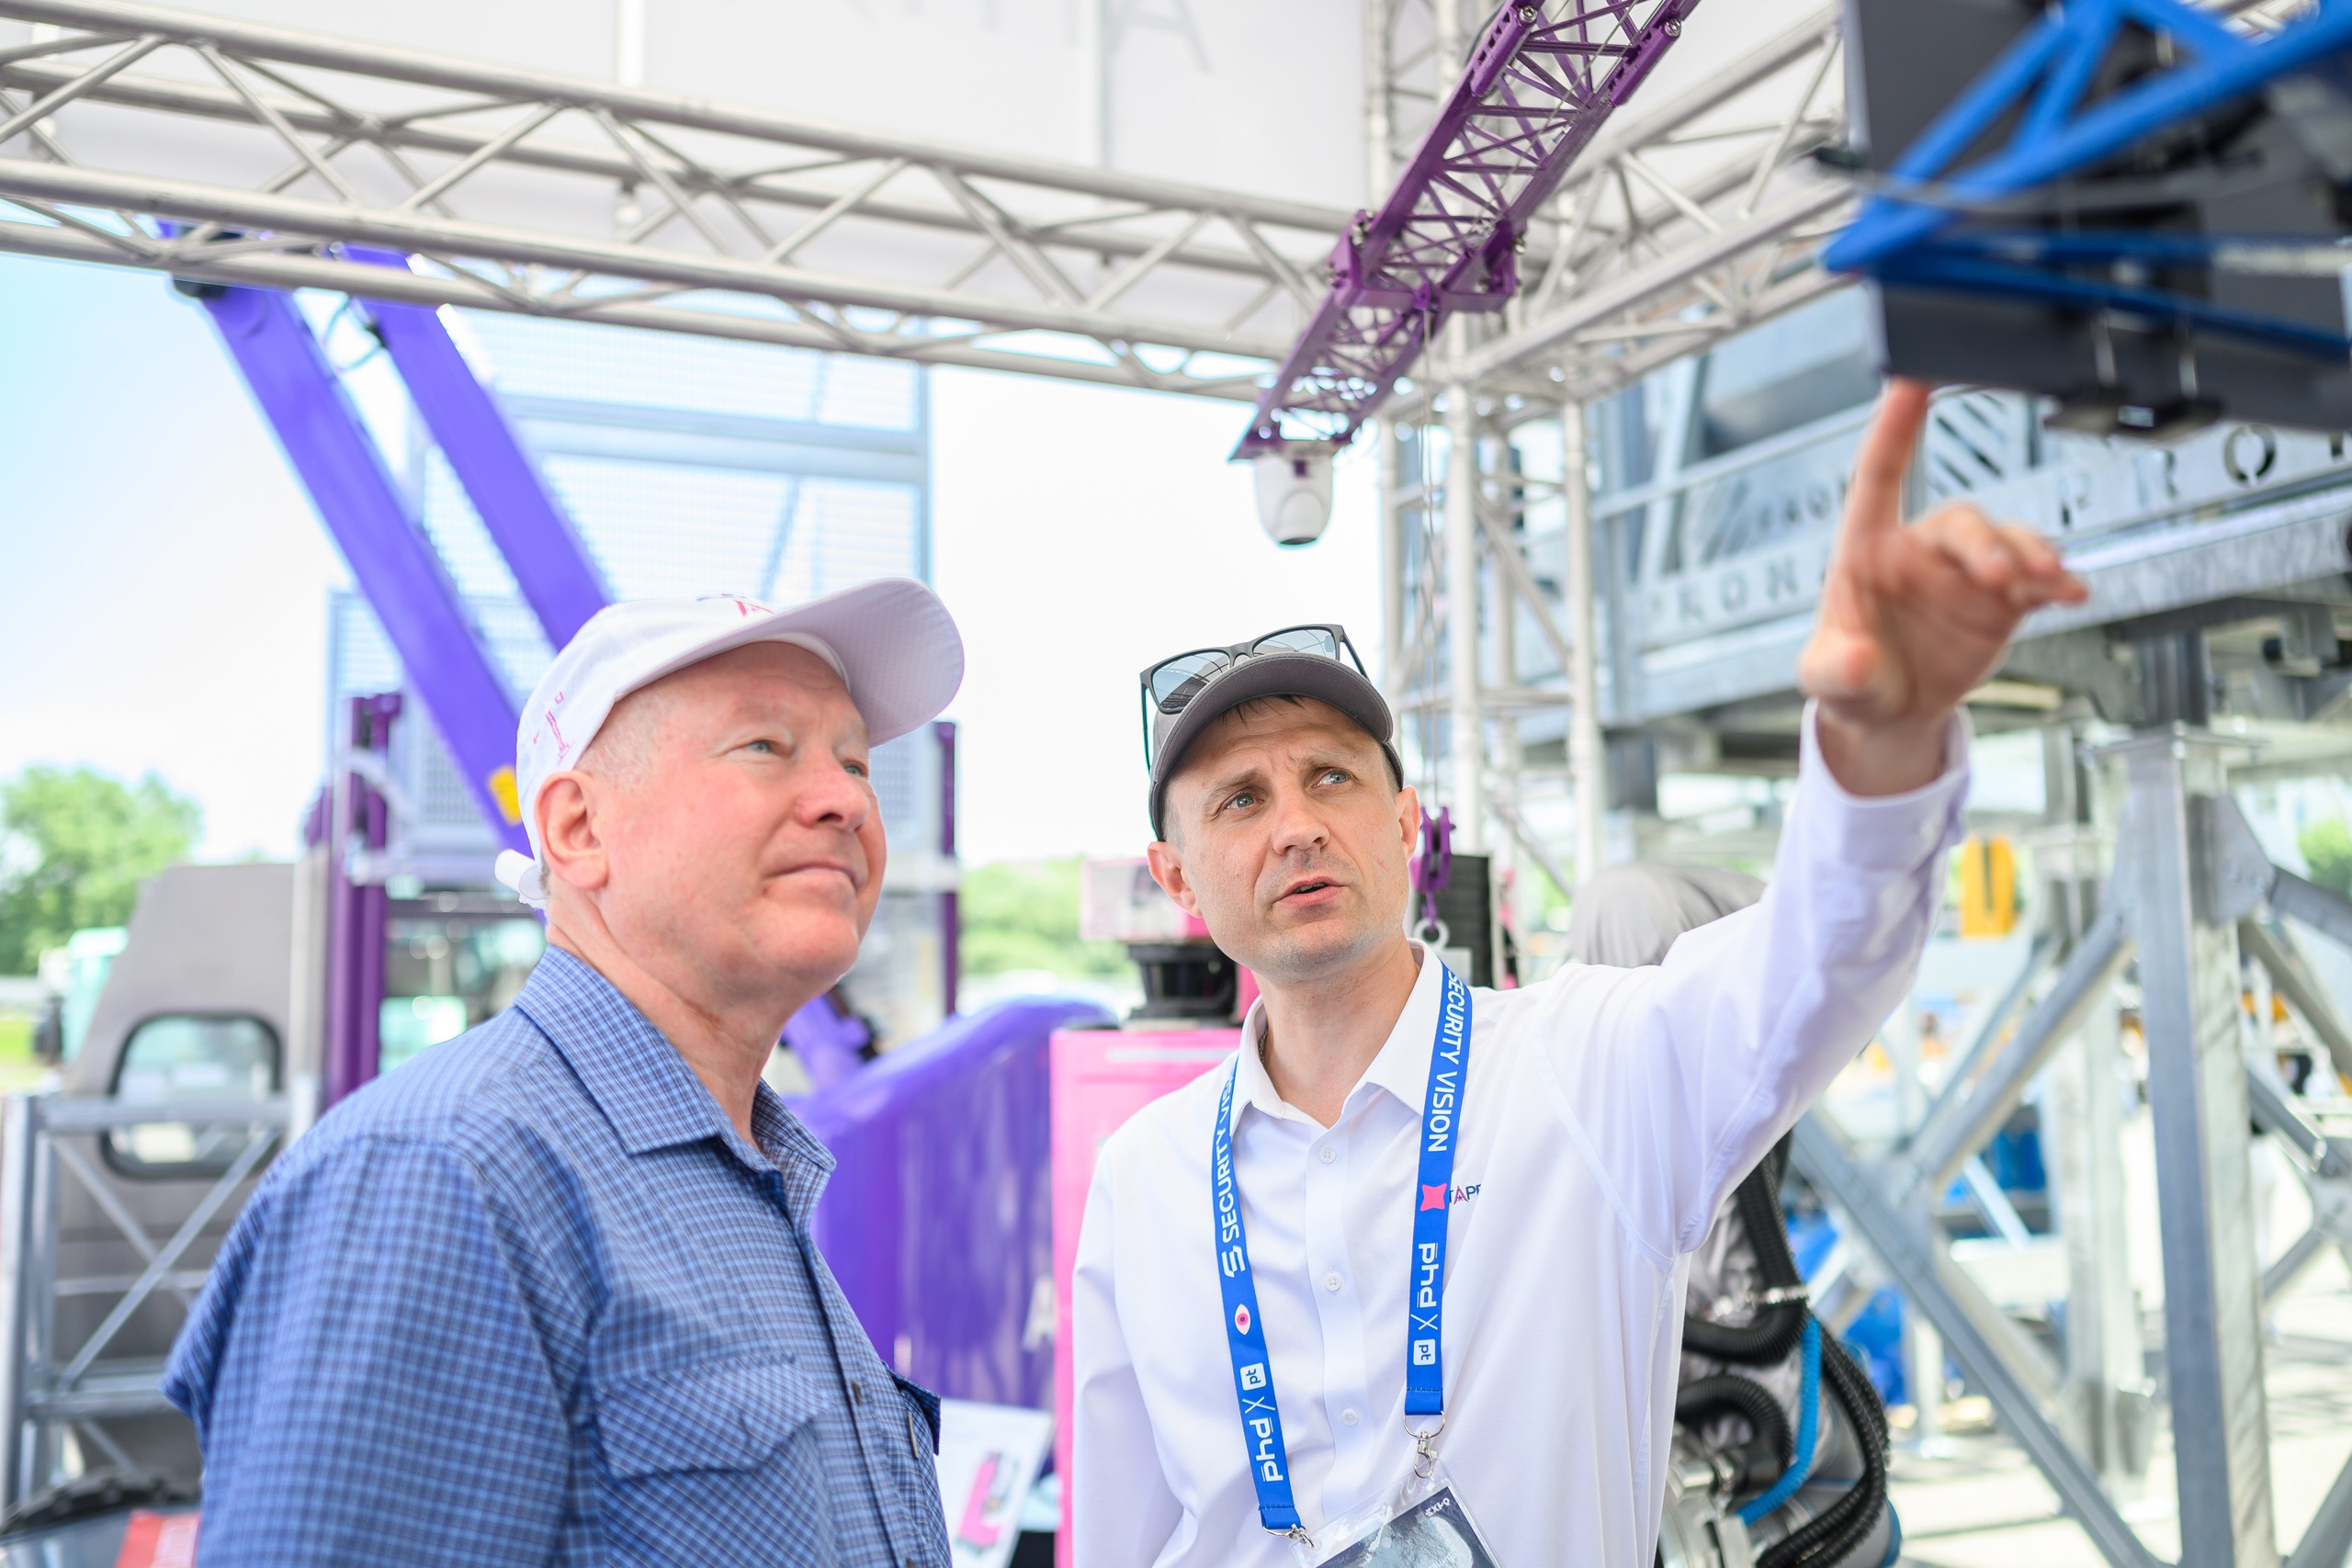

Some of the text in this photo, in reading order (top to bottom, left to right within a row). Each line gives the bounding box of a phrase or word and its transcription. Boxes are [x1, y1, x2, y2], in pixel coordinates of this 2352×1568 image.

[1428, 970, 1465, 1153] SECURITY VISION
[1216, 1127, 1240, 1244] SECURITY
[1245, 1368, 1261, 1385] pt
[1418, 1344, 1431, 1361] pt
